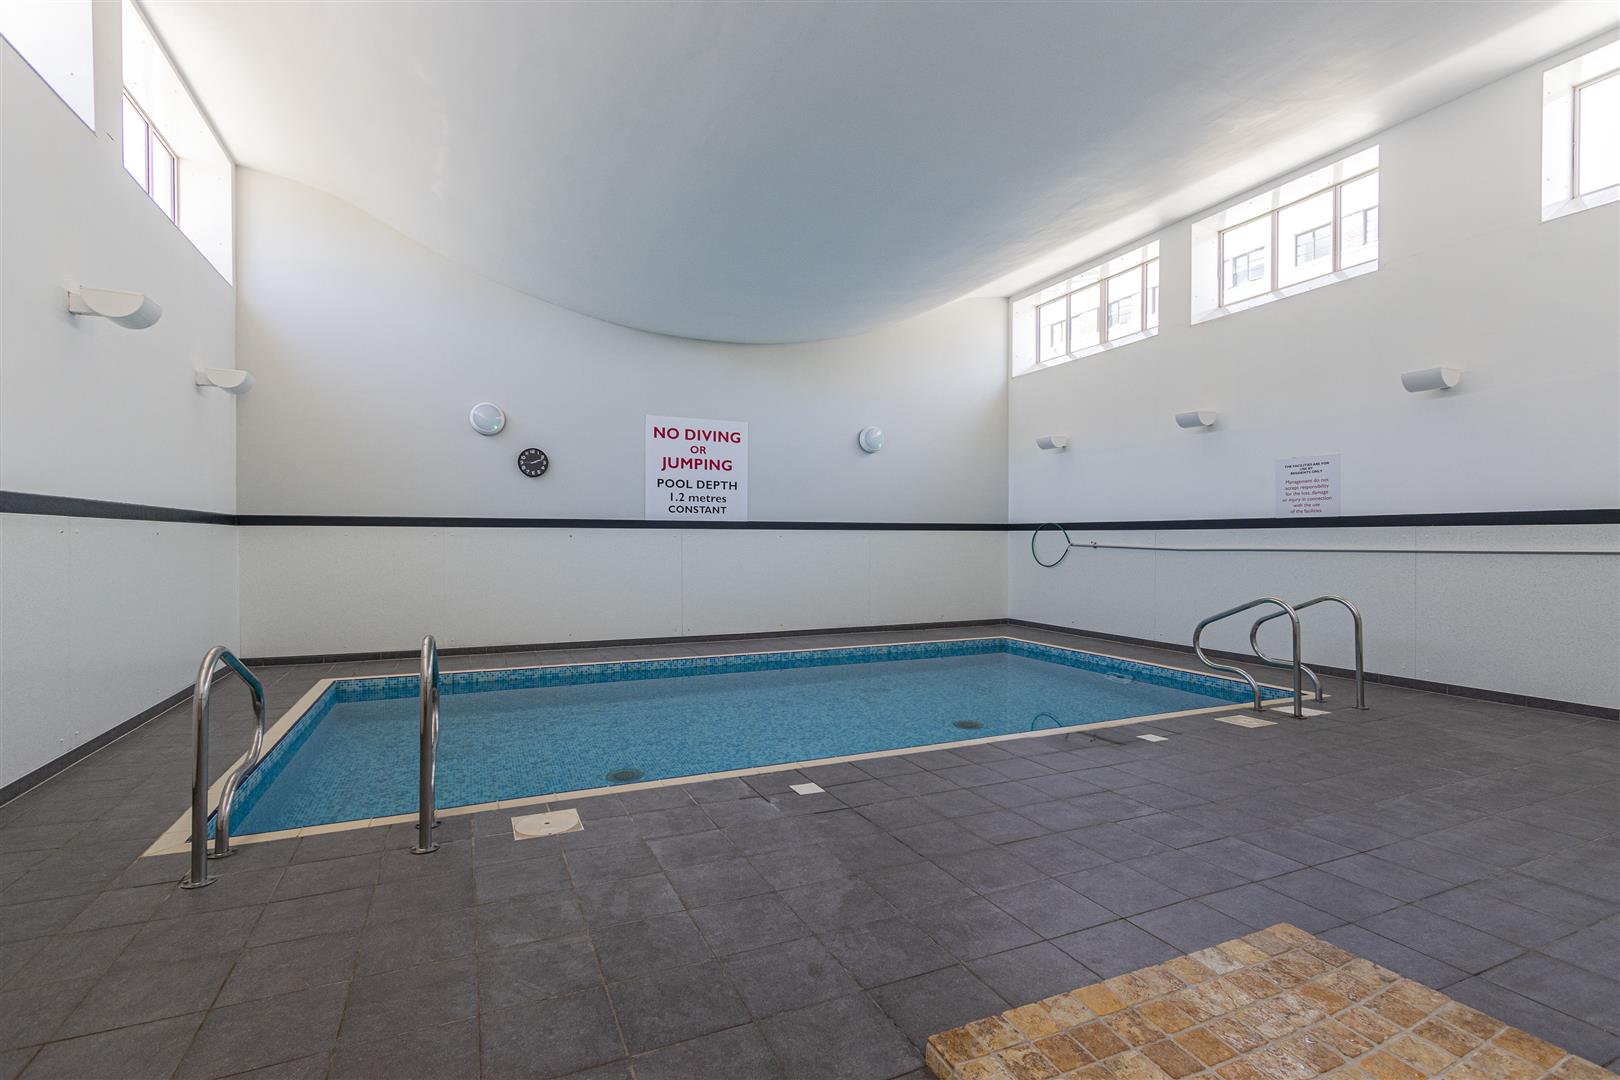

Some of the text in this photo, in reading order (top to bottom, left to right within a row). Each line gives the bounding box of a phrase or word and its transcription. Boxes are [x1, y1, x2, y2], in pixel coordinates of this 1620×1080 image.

[653, 426, 741, 444] NO DIVING
[690, 445, 707, 455] OR
[661, 456, 733, 471] JUMPING
[657, 478, 738, 490] POOL DEPTH
[670, 492, 727, 503] 1.2 metres
[668, 505, 727, 514] CONSTANT
